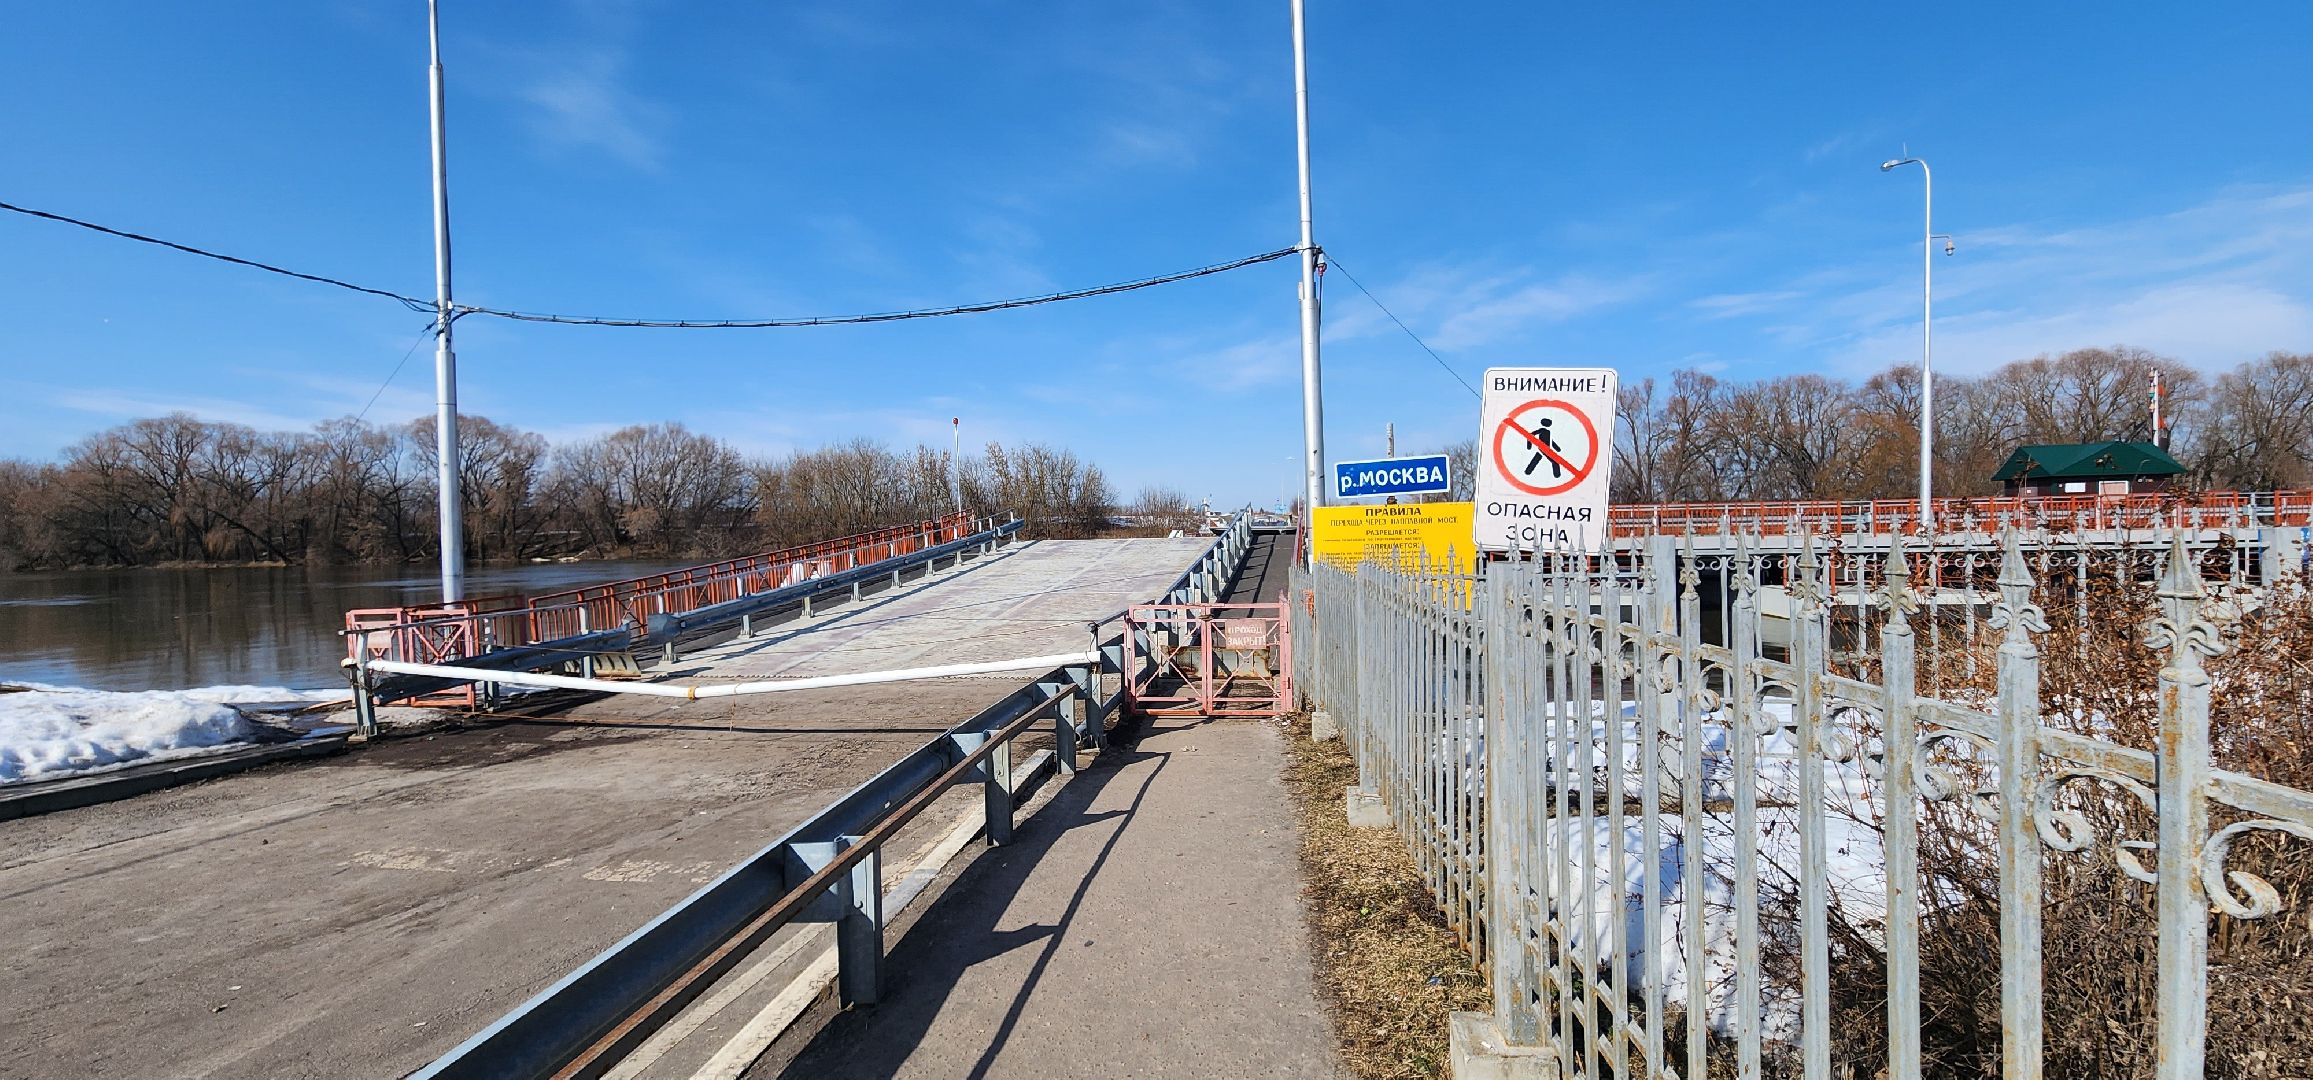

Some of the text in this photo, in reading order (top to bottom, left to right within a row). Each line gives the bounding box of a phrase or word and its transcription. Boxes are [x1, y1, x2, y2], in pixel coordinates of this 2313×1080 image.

[1365, 507, 1421, 517] ПРАВИЛА
[1487, 502, 1592, 522] ОПАСНАЯ
[1505, 525, 1569, 543] ЗОНА
[1227, 625, 1262, 634] ПРОХОД
